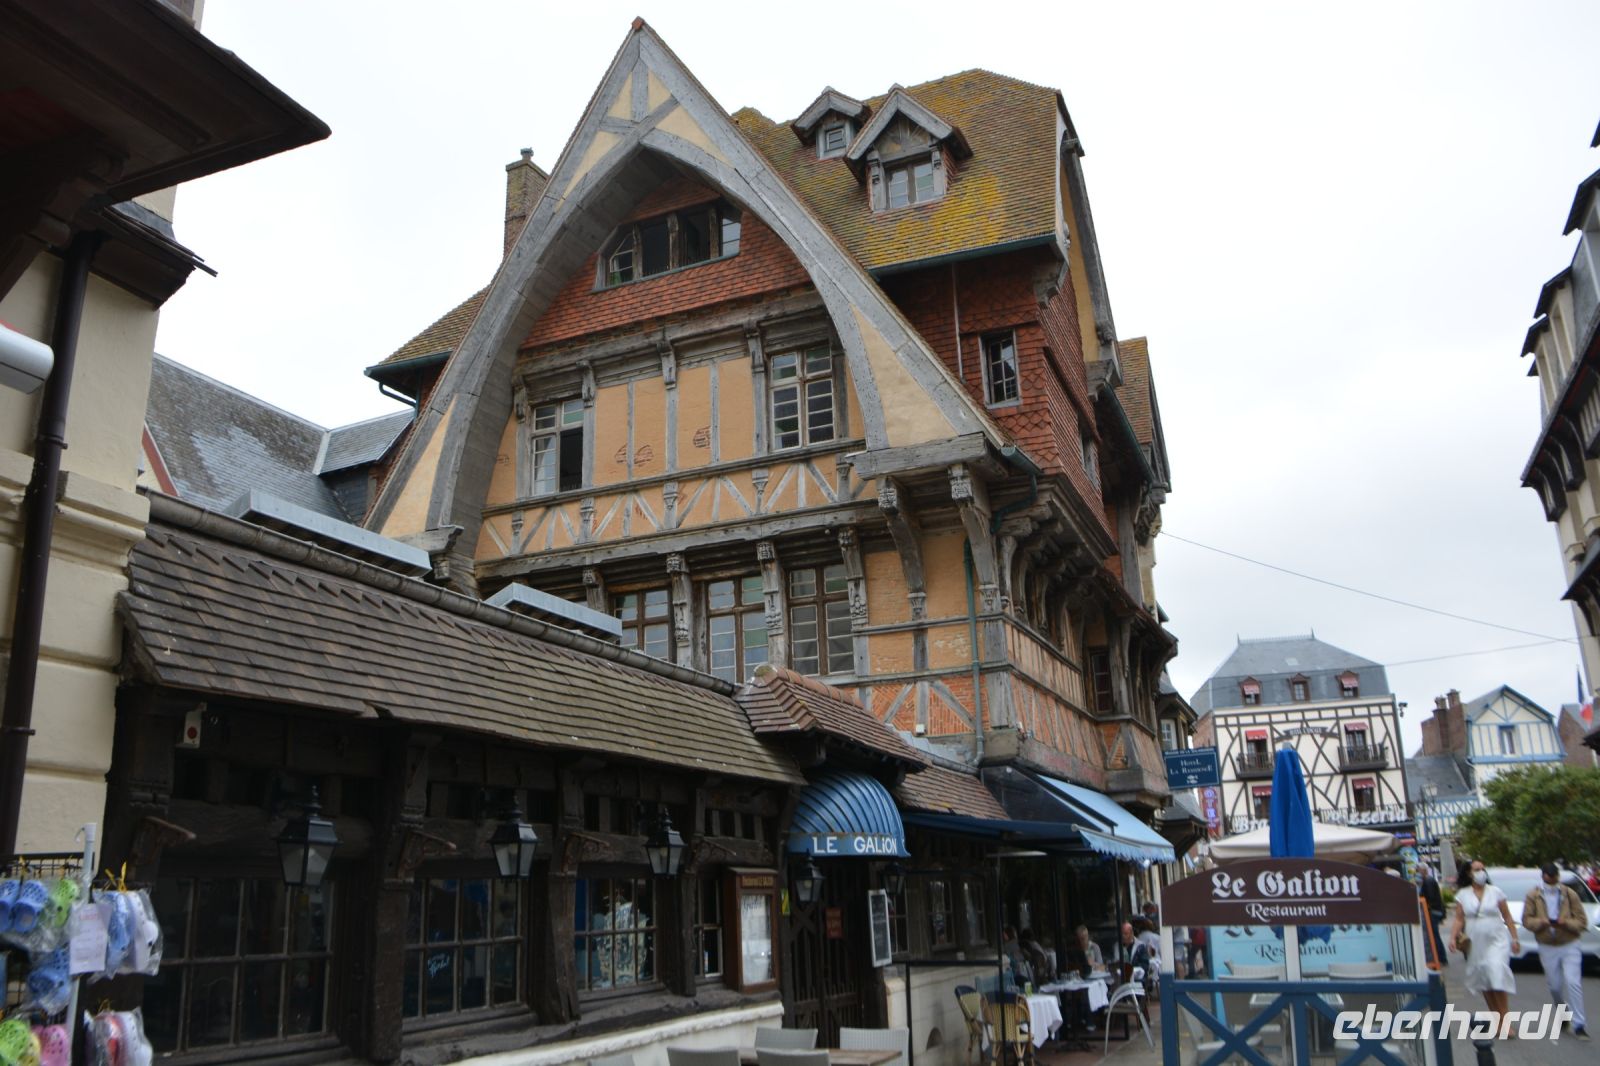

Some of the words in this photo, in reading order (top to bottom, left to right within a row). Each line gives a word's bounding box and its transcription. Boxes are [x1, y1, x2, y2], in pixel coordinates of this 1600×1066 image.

[812, 836, 838, 854] LE
[1211, 871, 1247, 898] Le
[1256, 868, 1361, 898] Galion
[1245, 902, 1328, 923] Restaurant
